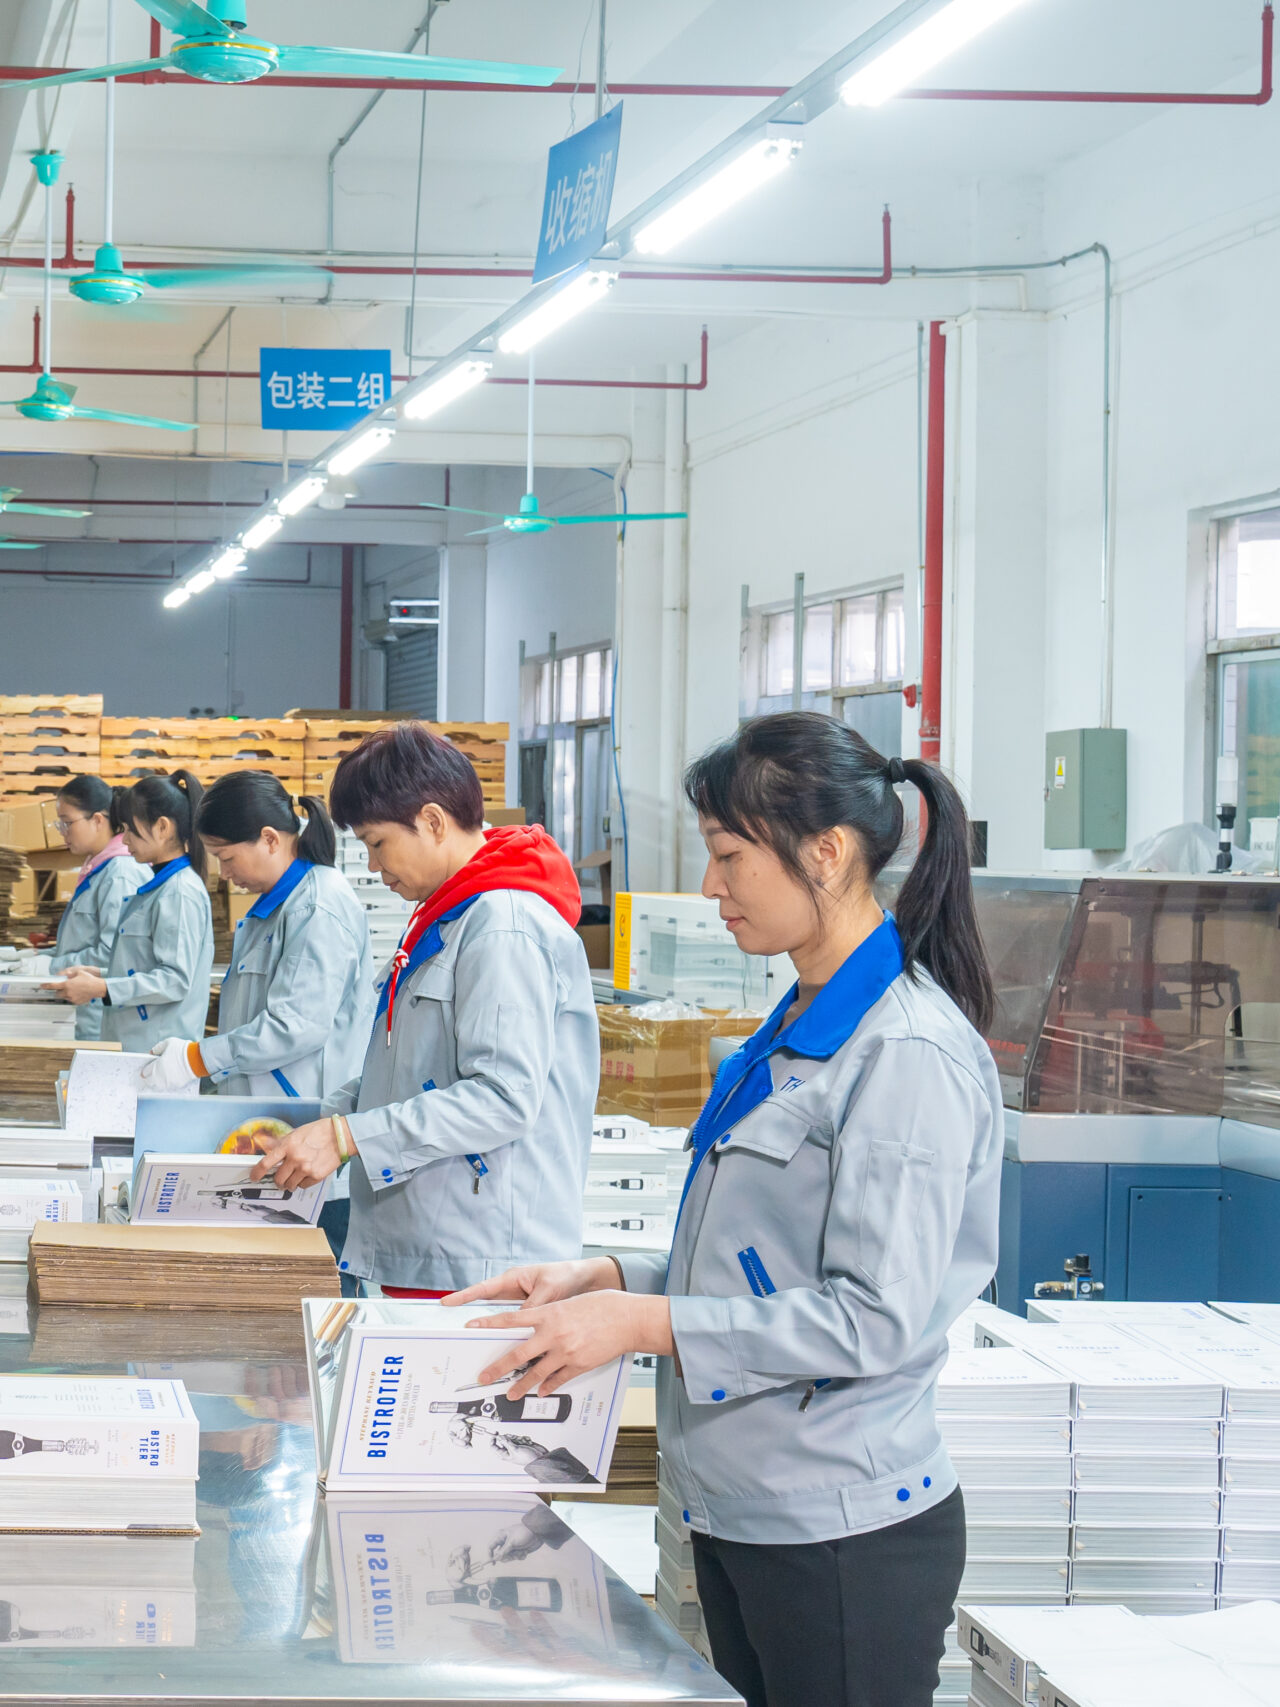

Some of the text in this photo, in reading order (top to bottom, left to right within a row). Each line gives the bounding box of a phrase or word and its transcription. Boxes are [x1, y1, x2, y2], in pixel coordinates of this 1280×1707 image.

[544, 150, 613, 255] 收缩机
[267, 371, 384, 410] 包装二组
[156, 1172, 180, 1213] BISTROTIER
[366, 1355, 404, 1458] BISTROTIER
[139, 1437, 149, 1460] TIER
[150, 1430, 160, 1467] BISTRO
